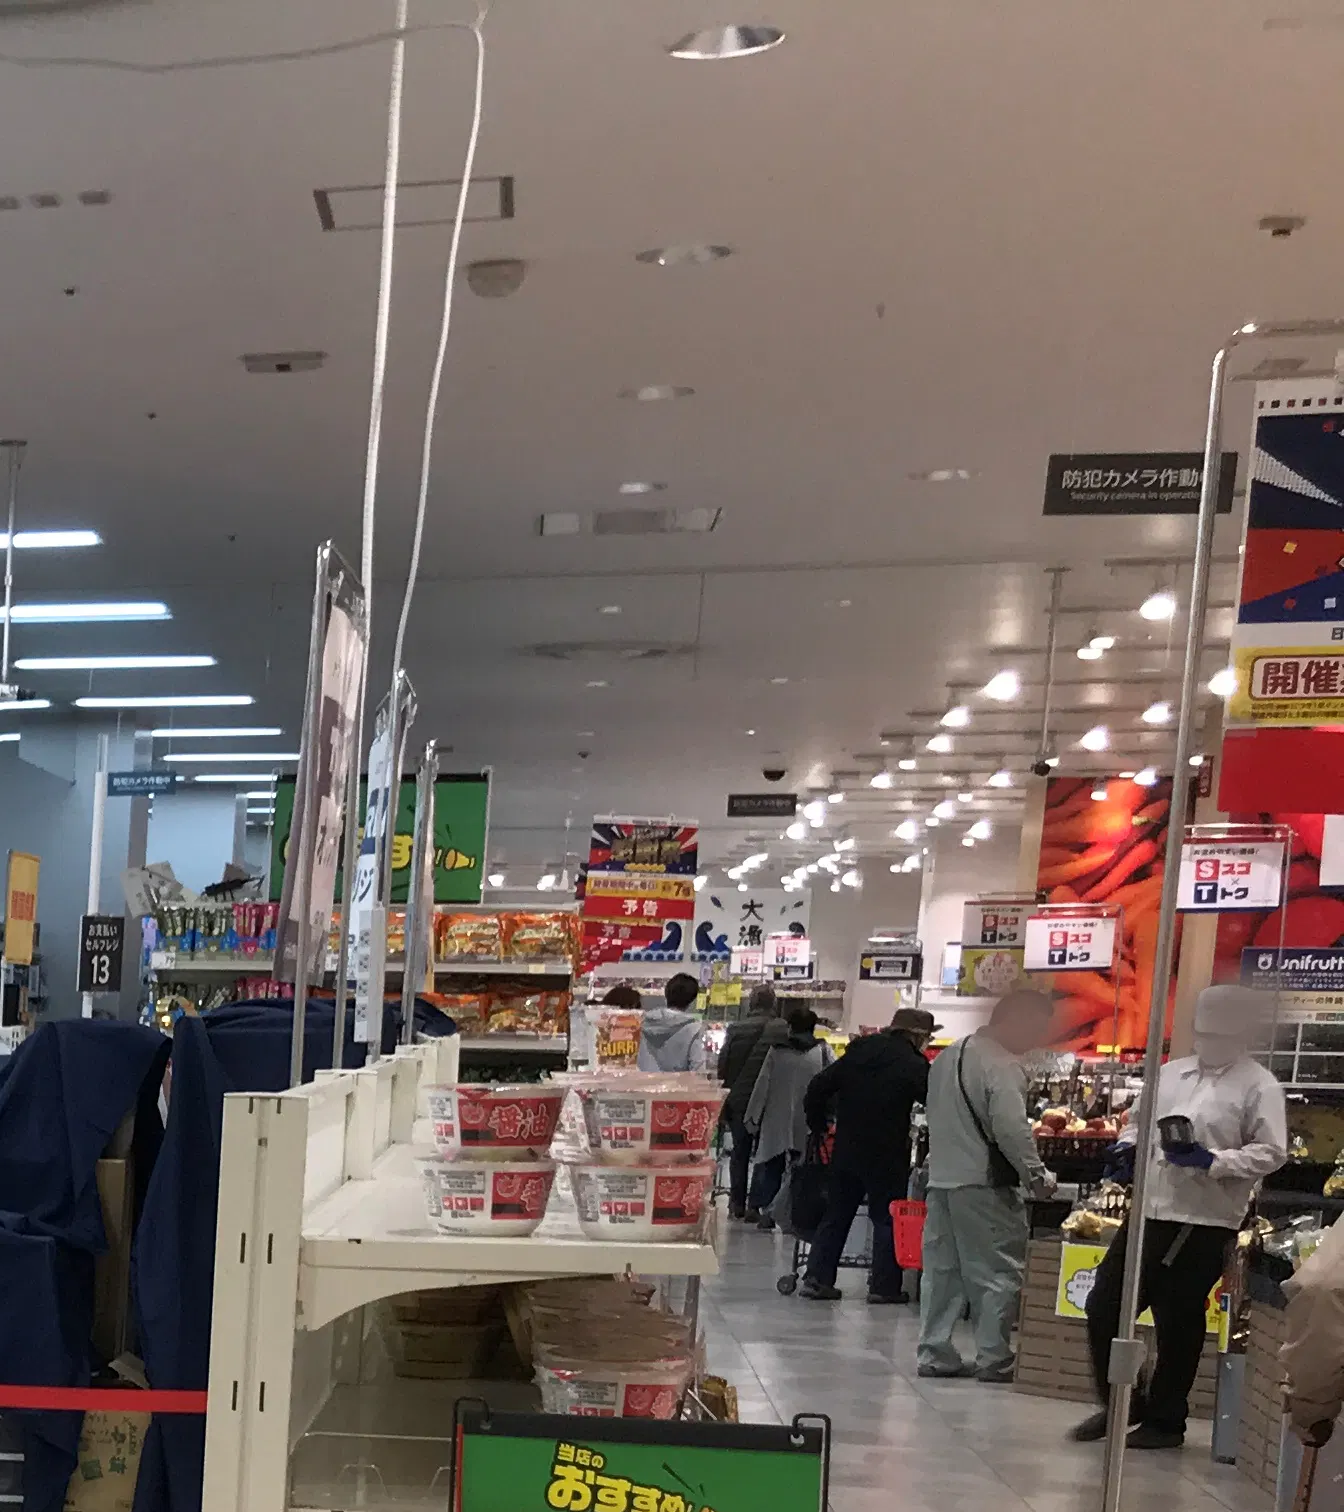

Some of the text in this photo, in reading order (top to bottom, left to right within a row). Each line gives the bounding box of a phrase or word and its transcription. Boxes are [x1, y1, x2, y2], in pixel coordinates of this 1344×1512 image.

[1062, 468, 1204, 489] 防犯カメラ作動
[1071, 491, 1109, 501] Security
[1112, 491, 1146, 500] camera
[1159, 491, 1200, 501] operatio
[1261, 660, 1344, 695] 開催
[1199, 861, 1214, 878] S
[1197, 885, 1249, 900] T トク
[88, 924, 118, 937] お支払い
[85, 938, 119, 951] セルフレジ
[91, 954, 110, 985] 13
[557, 1443, 605, 1469] 当店の
